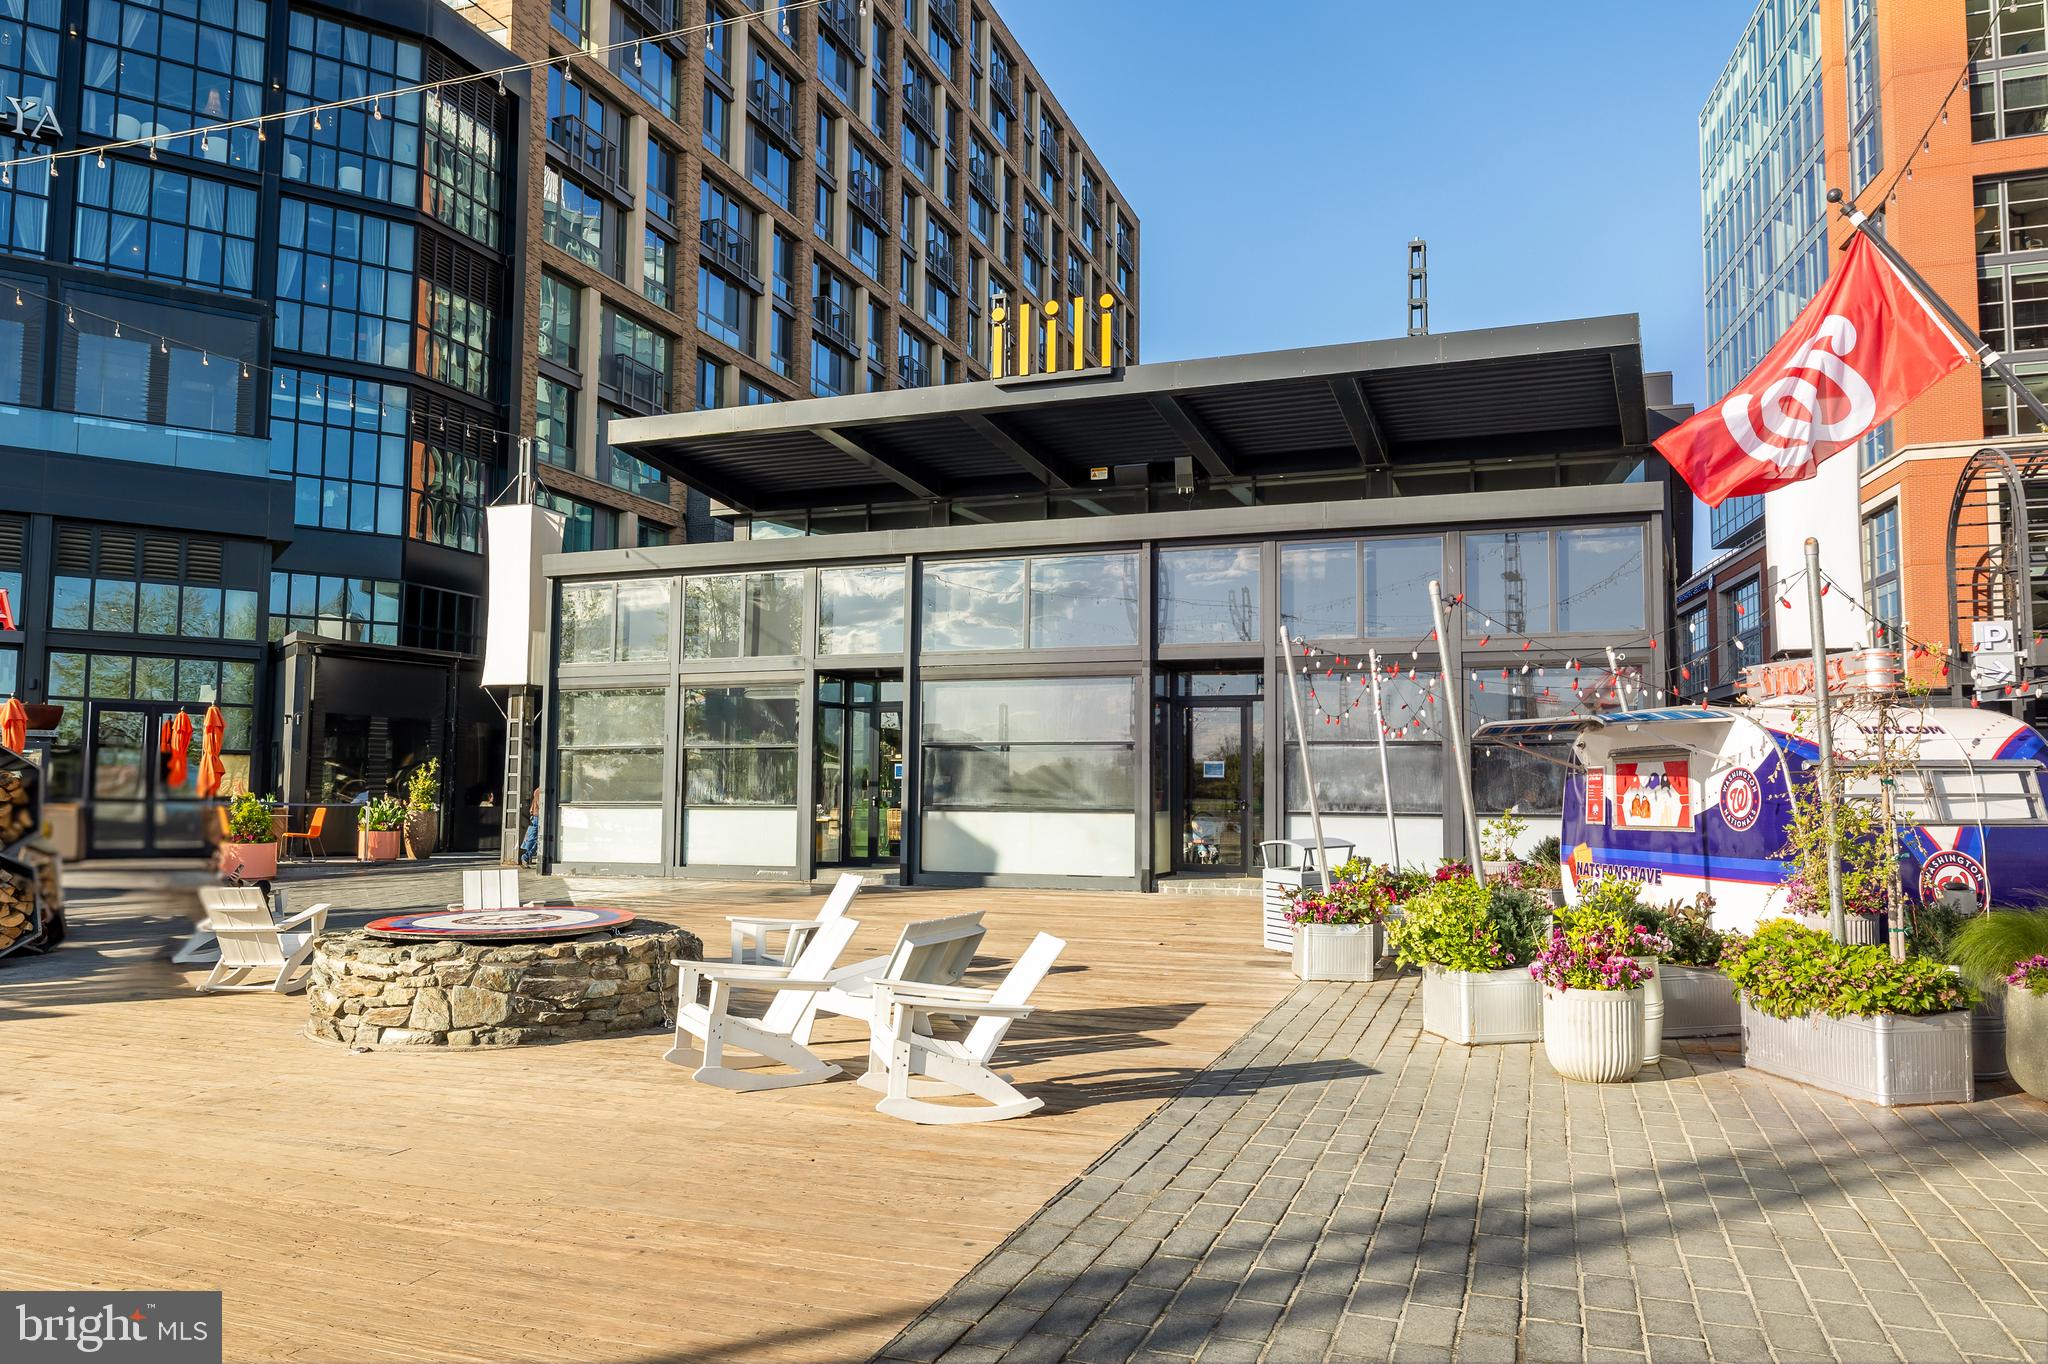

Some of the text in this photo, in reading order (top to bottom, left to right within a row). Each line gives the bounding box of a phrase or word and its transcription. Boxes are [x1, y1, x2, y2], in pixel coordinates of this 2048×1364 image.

[992, 294, 1114, 378] ilili
[1984, 625, 2008, 650] P
[1722, 770, 1758, 793] WASHINGTON
[1724, 808, 1757, 828] NATIONALS
[1576, 861, 1663, 885] NATS FANS HAVE
